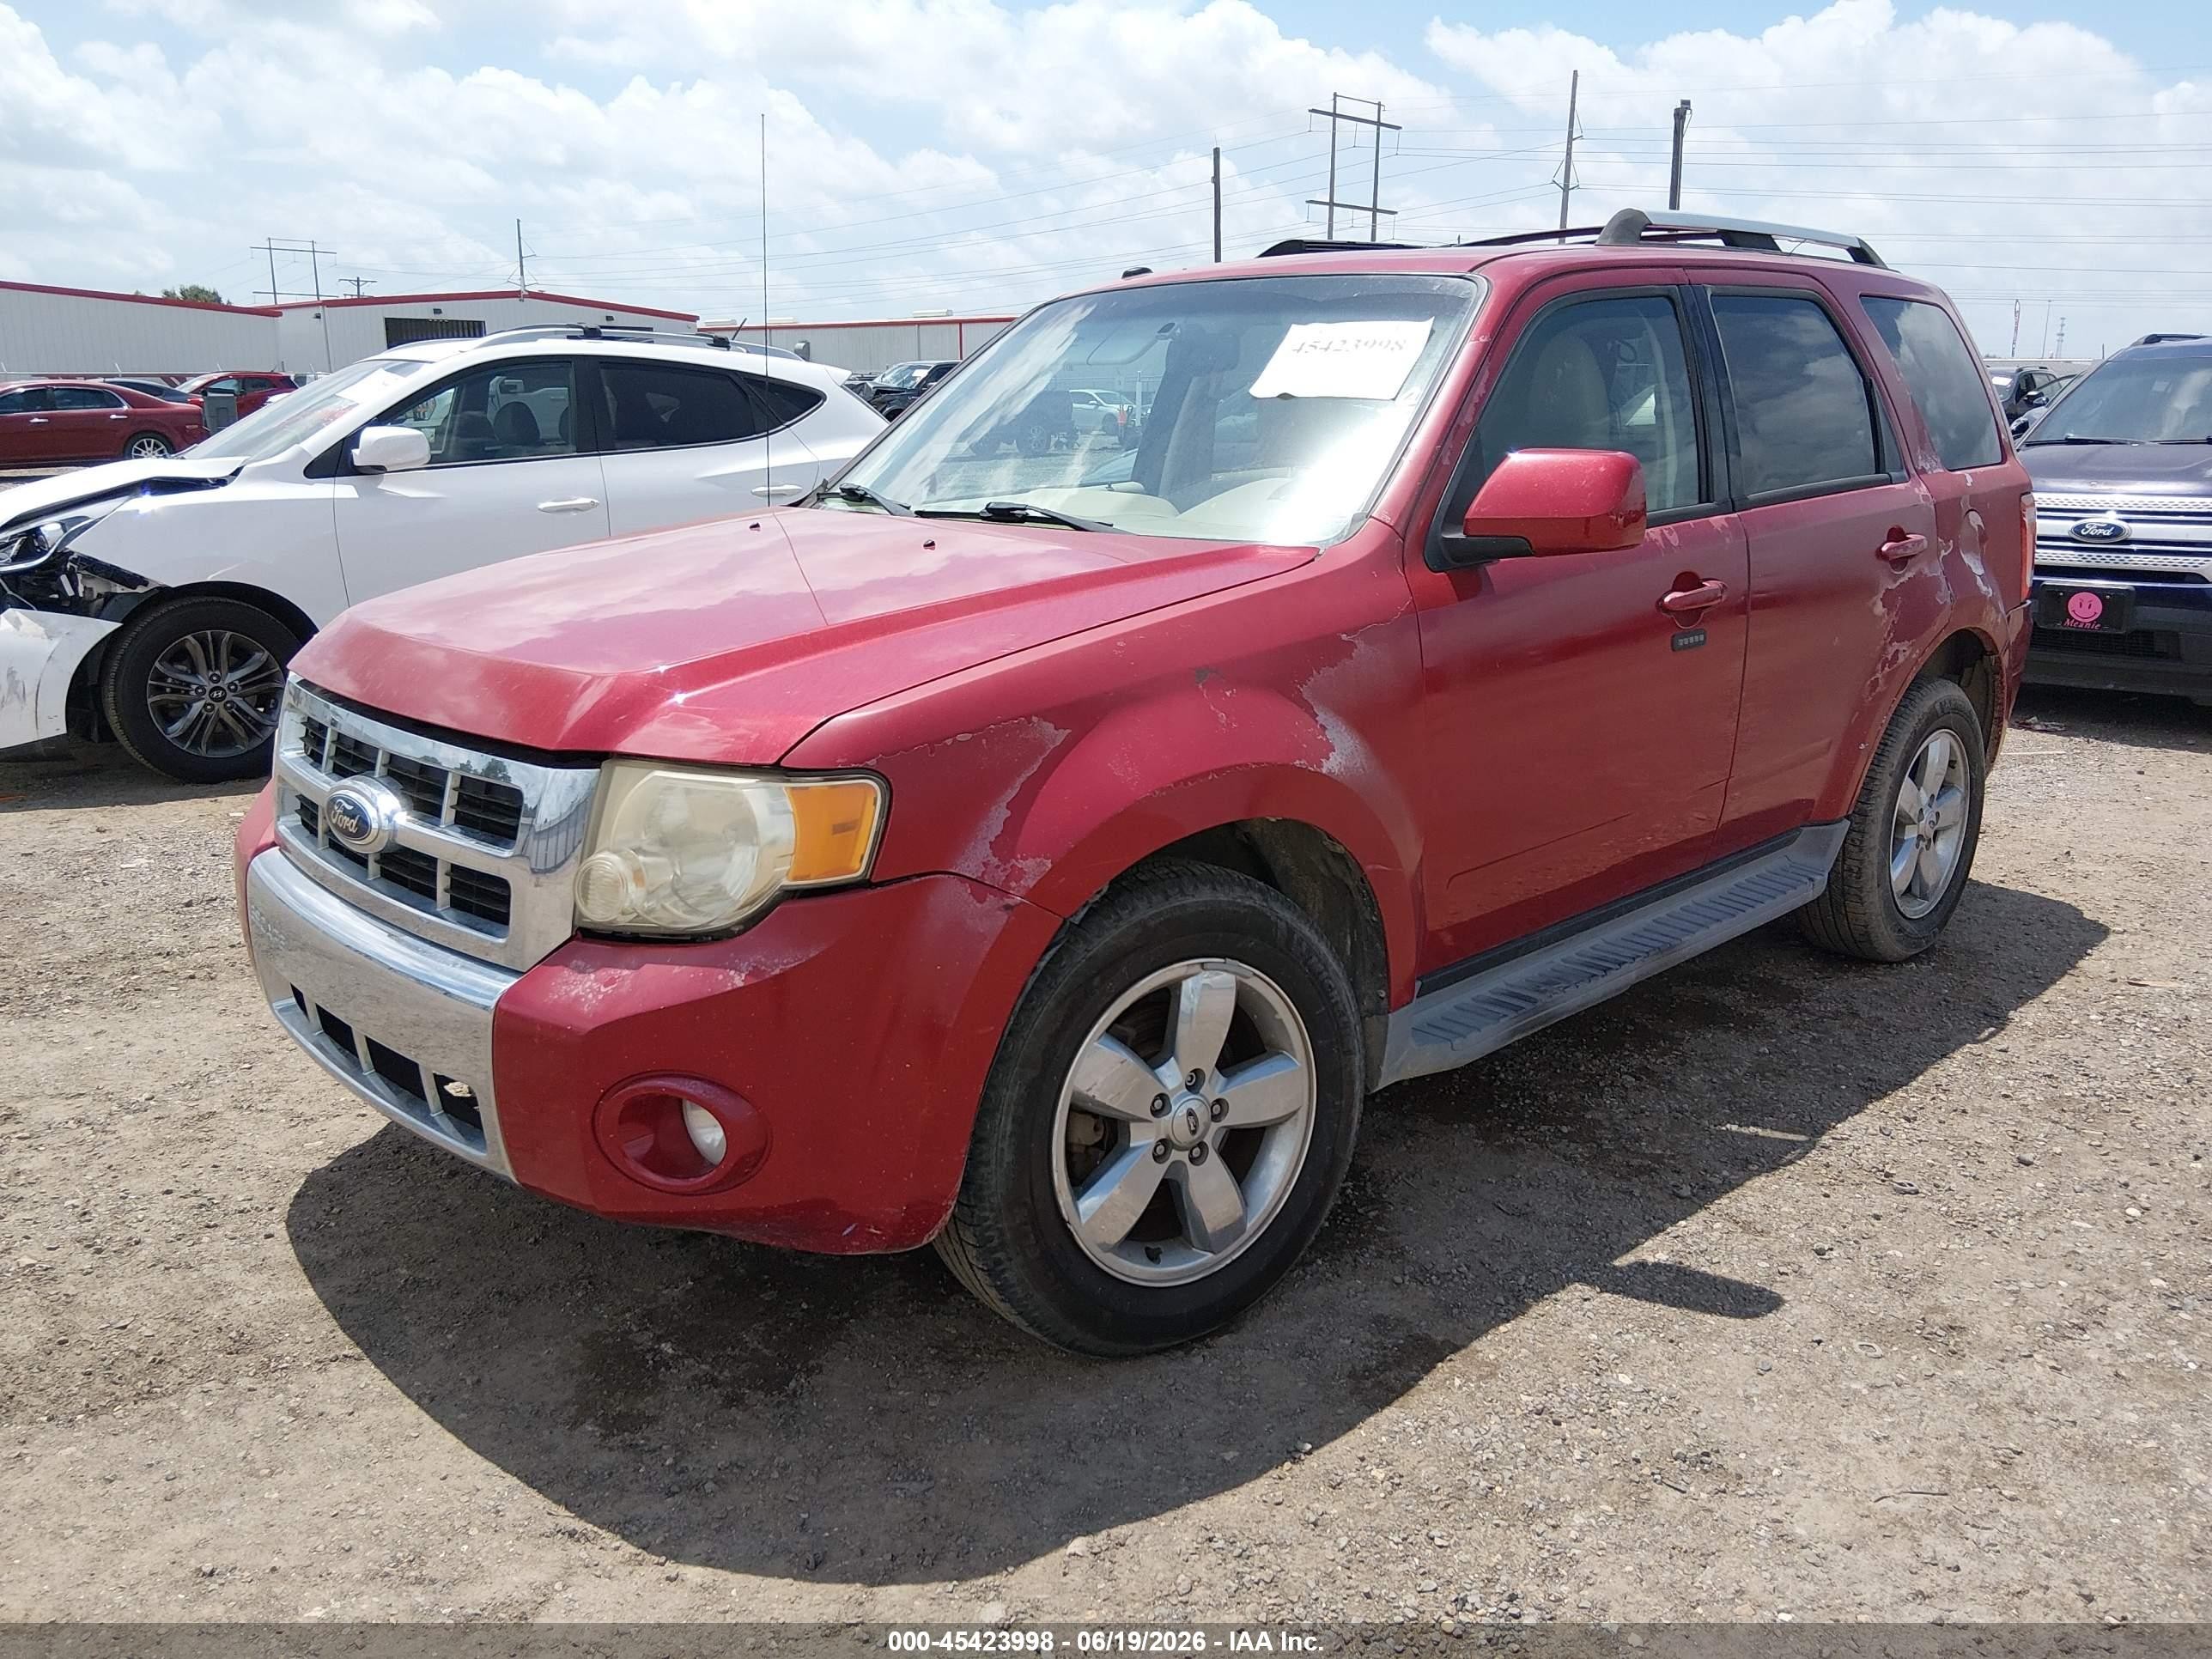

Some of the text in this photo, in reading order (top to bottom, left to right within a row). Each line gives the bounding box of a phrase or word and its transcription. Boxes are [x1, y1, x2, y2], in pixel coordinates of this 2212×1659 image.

[2081, 522, 2115, 536] Ford
[2063, 618, 2102, 630] Meanie
[331, 799, 361, 834] Ford
